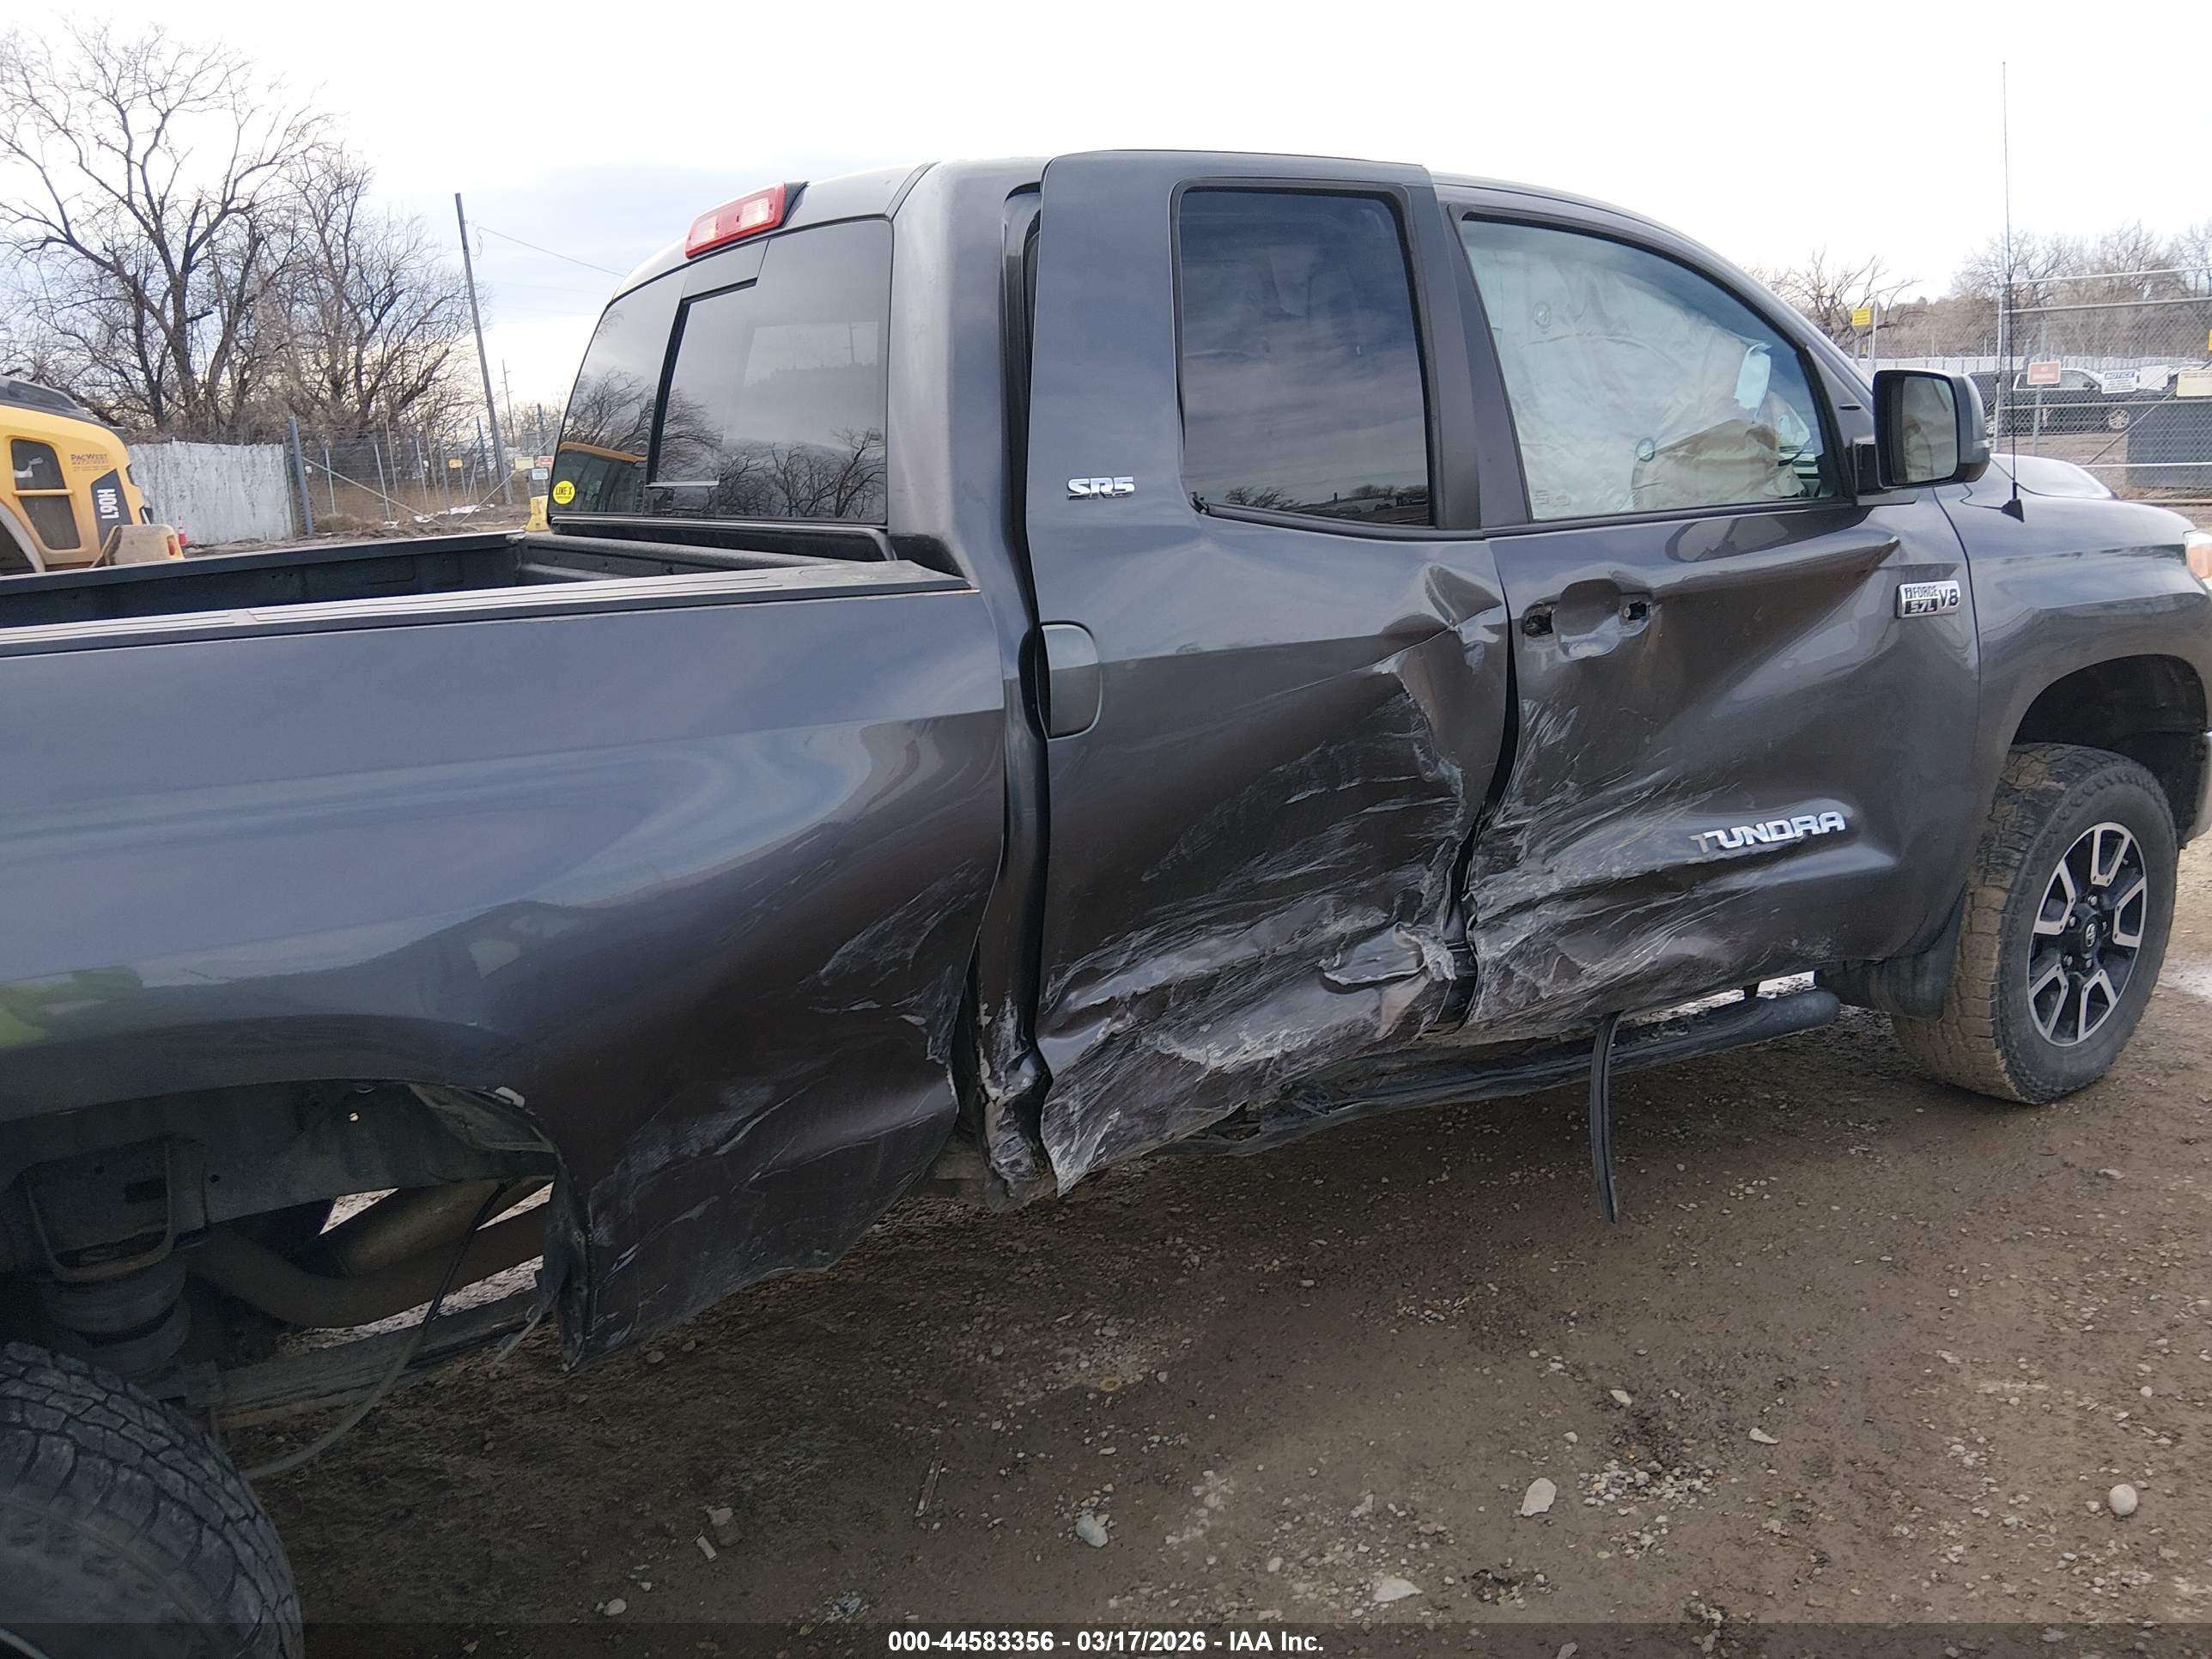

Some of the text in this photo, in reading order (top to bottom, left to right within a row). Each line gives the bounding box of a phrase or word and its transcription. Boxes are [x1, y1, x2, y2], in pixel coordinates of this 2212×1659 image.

[1067, 477, 1135, 497] SR5
[96, 488, 119, 520] L90H
[1938, 587, 1959, 607] V8
[1689, 811, 1846, 854] TUNDRA
